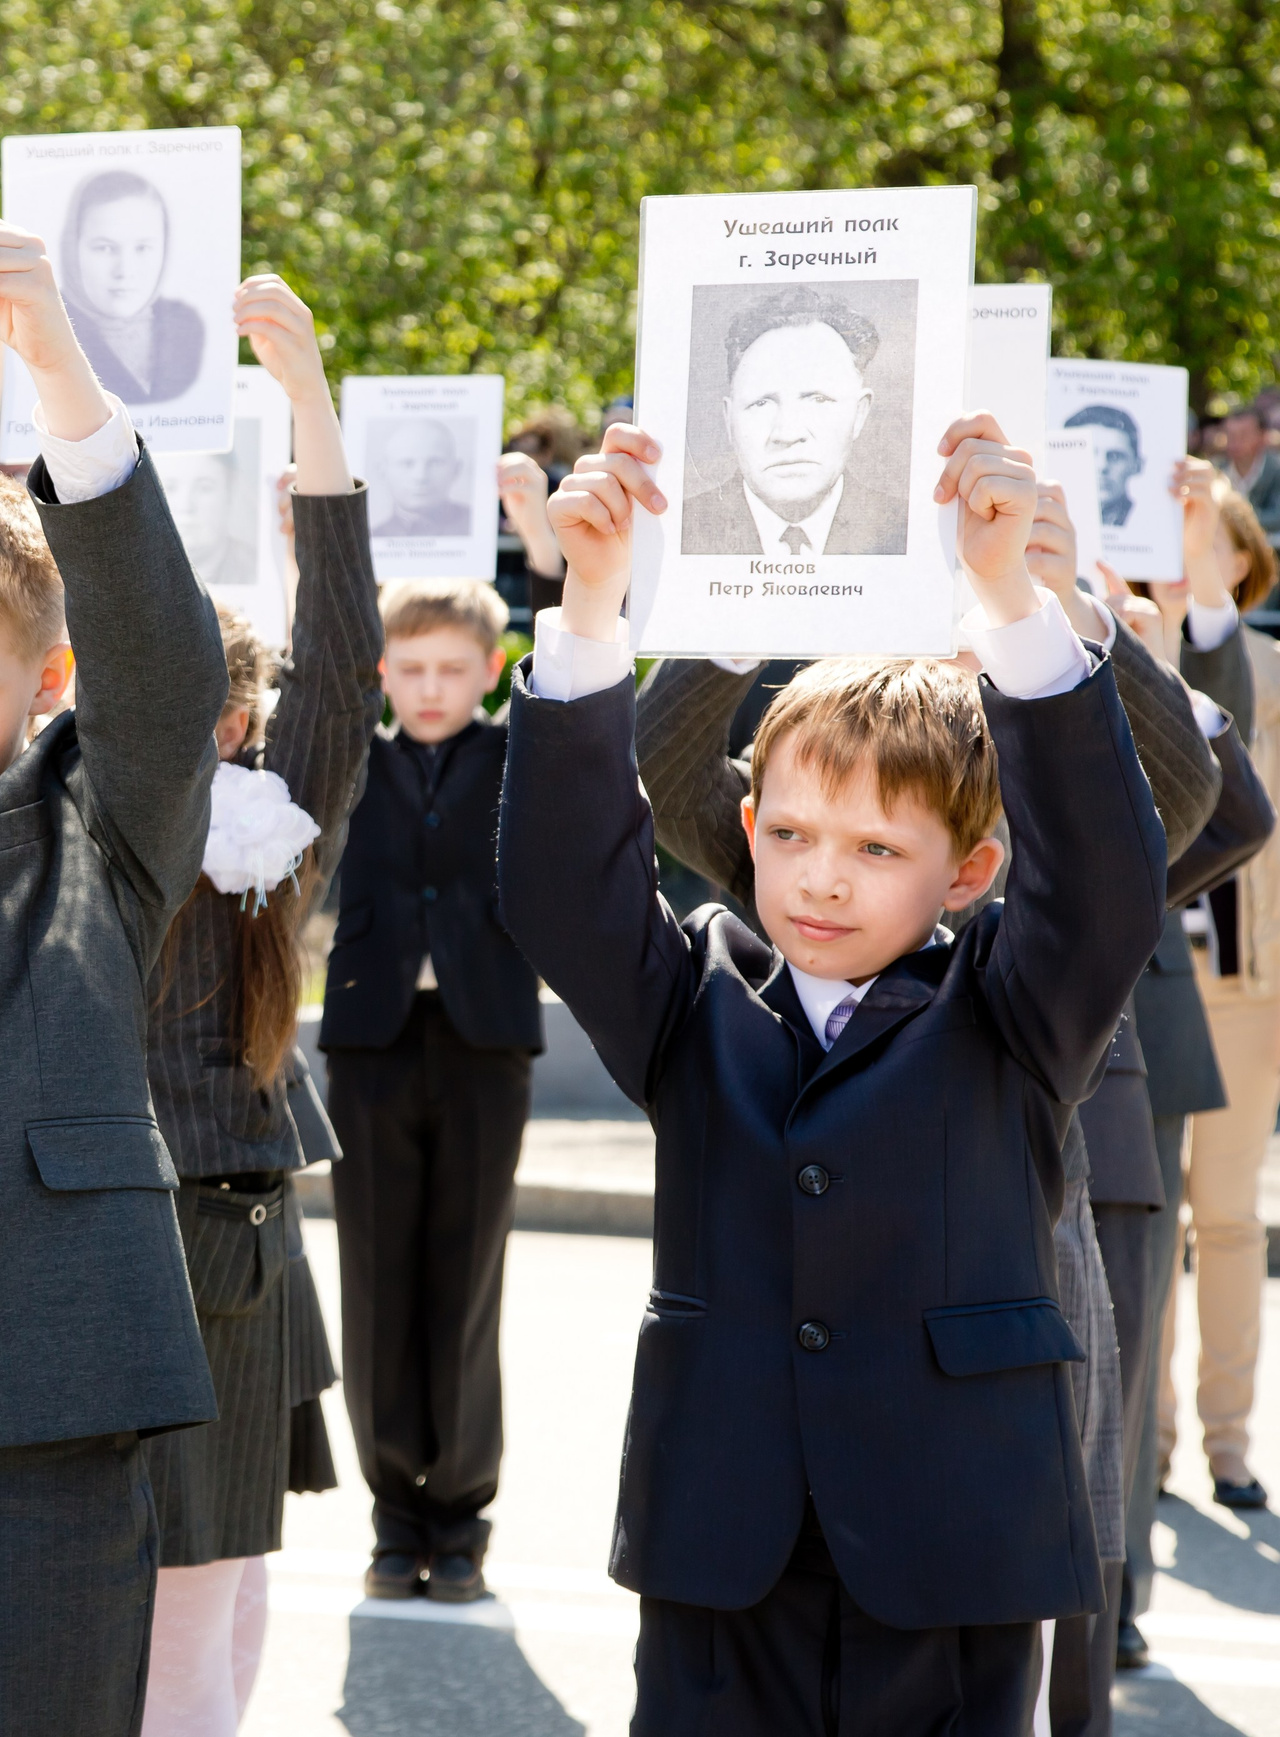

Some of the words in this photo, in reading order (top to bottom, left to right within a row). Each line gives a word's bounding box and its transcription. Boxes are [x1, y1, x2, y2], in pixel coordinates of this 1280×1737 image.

[26, 144, 95, 159] Ушедший
[148, 140, 224, 155] Заречного
[723, 216, 834, 238] Ушедший
[844, 217, 900, 233] полк
[739, 254, 752, 268] г.
[764, 247, 877, 270] Заречный
[973, 307, 1038, 319] ечного
[149, 414, 225, 428] Ивановна
[750, 560, 817, 575] Кислов
[709, 581, 754, 598] Петр
[762, 581, 863, 597] Яковлевич
